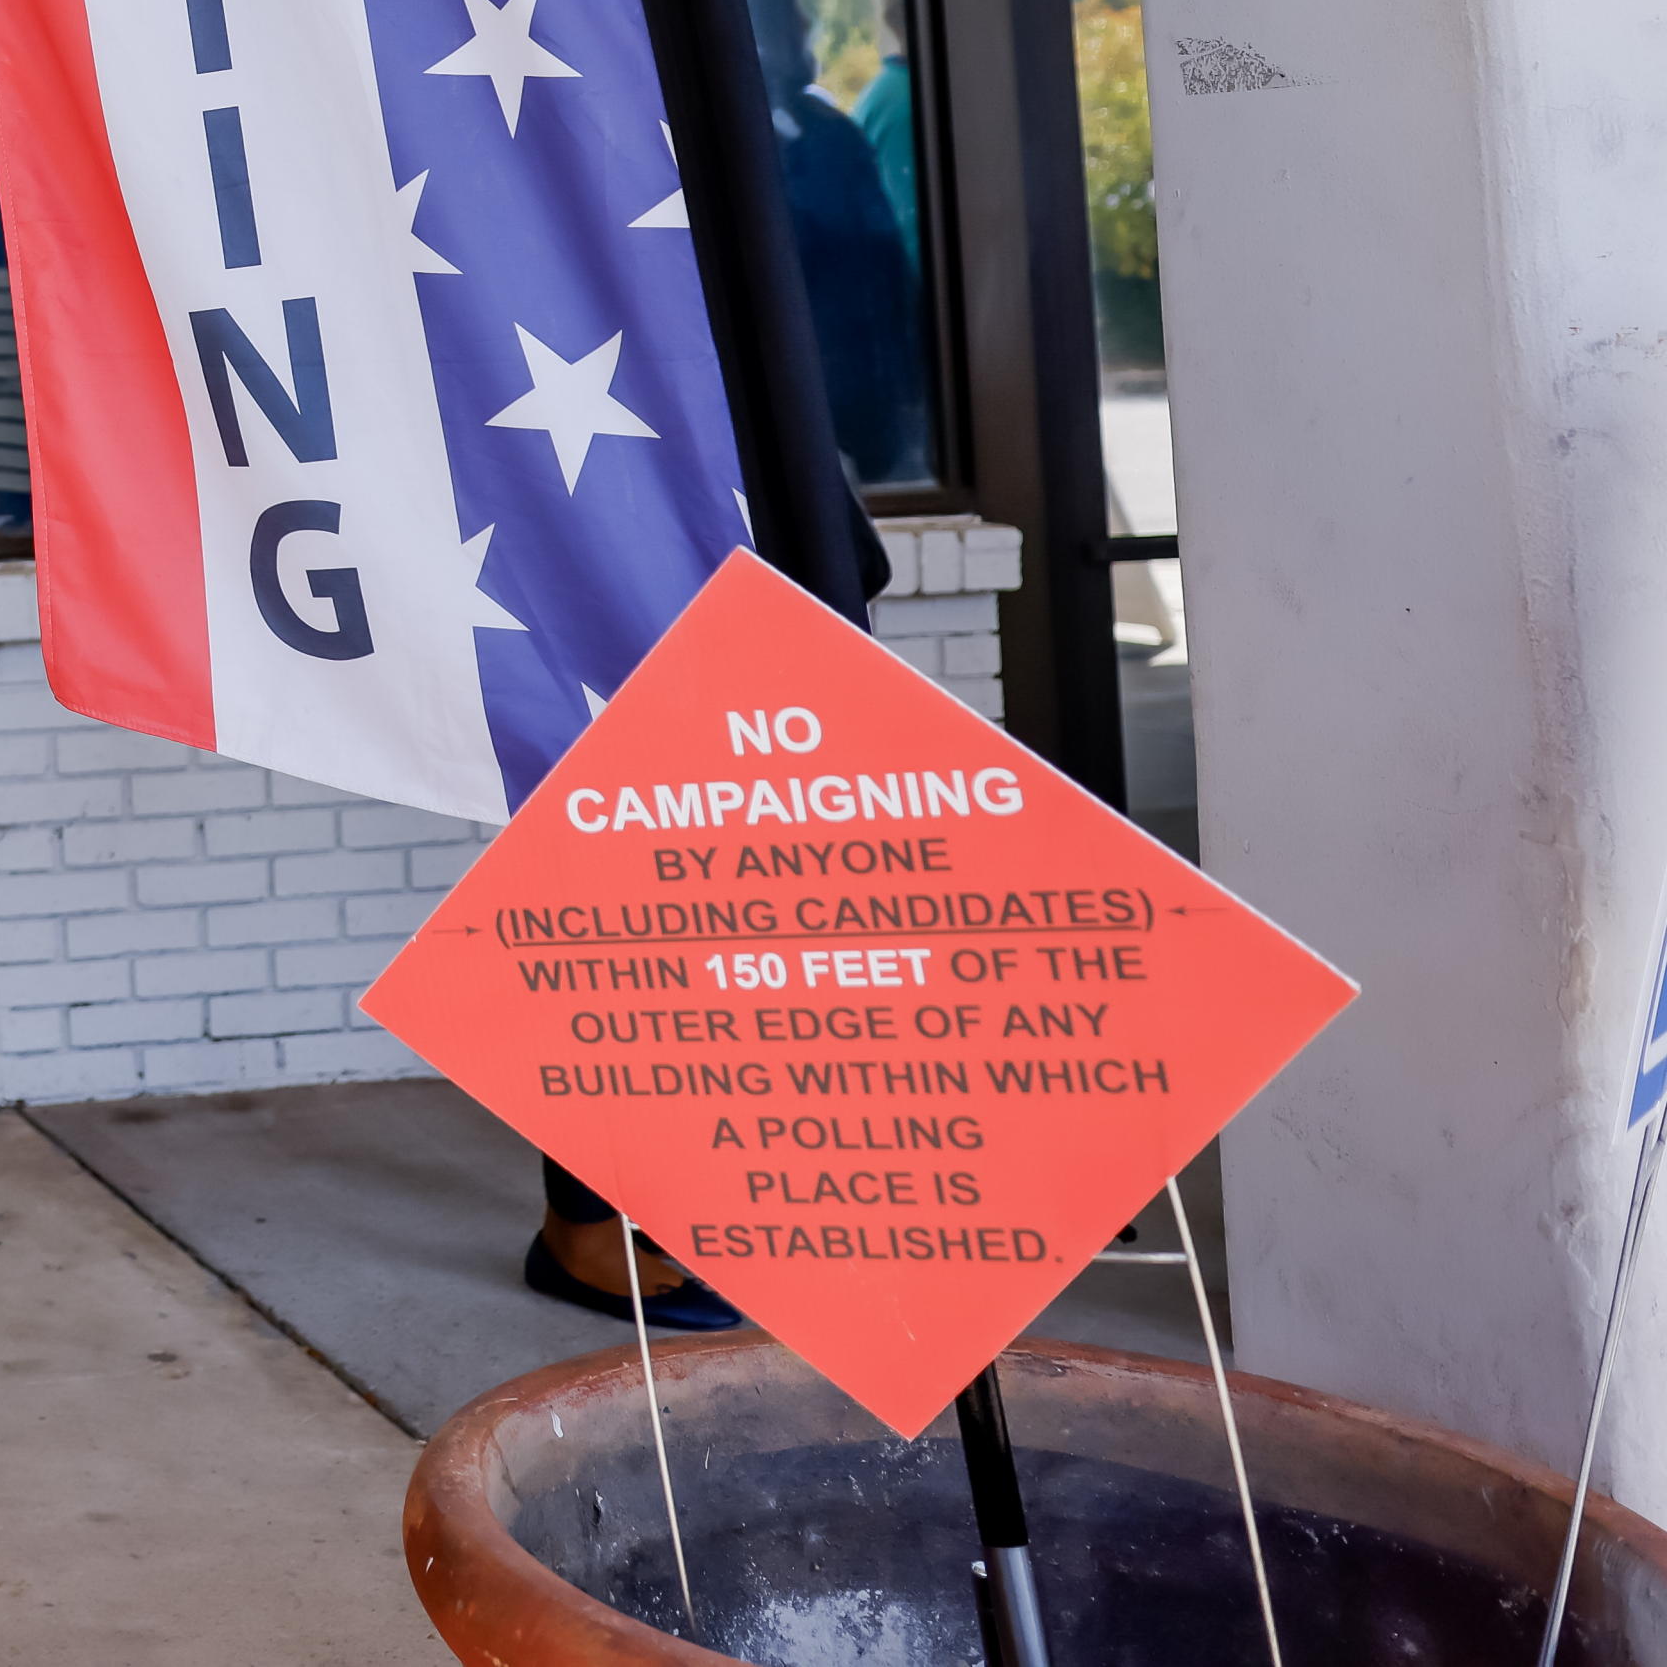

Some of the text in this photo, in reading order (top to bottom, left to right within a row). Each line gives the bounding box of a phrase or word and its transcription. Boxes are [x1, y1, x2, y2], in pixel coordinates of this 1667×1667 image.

[726, 706, 822, 756] NO
[565, 767, 1024, 834] CAMPAIGNING
[653, 838, 952, 882] BY ANYONE
[496, 890, 1153, 945] (INCLUDING CANDIDATES)
[517, 946, 1147, 992] WITHIN 150 FEET OF THE
[570, 1004, 1108, 1044] OUTER EDGE OF ANY
[539, 1059, 1169, 1097] BUILDING WITHIN WHICH
[712, 1116, 984, 1150] A POLLING
[746, 1171, 981, 1206] PLACE IS
[691, 1225, 1063, 1263] ESTABLISHED.
